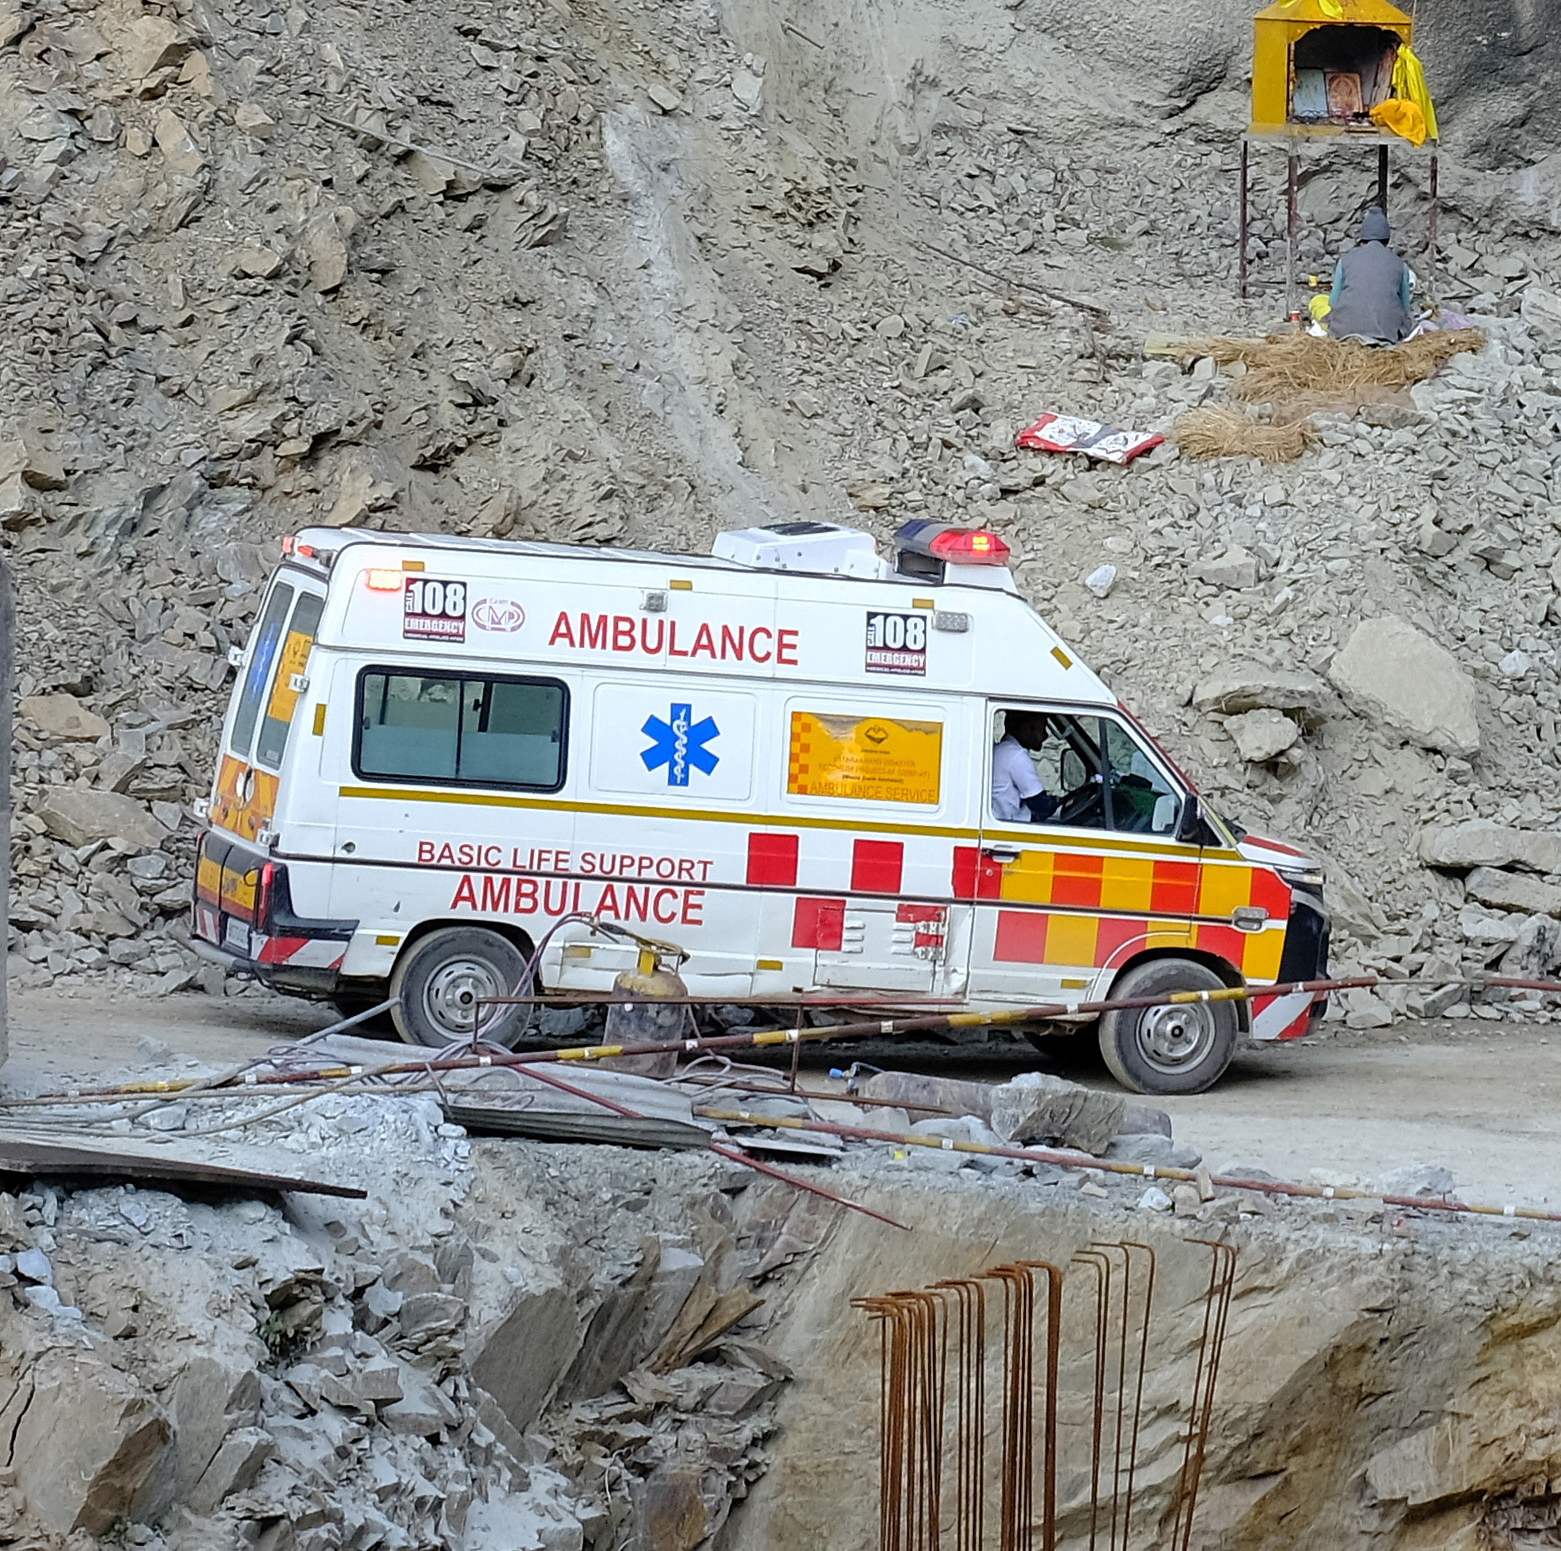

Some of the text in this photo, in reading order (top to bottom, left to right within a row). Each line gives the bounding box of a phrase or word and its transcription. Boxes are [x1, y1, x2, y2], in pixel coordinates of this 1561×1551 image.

[408, 580, 465, 618] 108
[404, 617, 465, 635] EMERGENCY
[548, 611, 799, 666] AMBULANCE
[869, 614, 925, 651] 108
[867, 651, 926, 668] EMERGENCY
[809, 780, 936, 802] AMBULANCE SERVICE
[417, 840, 714, 882] BASIC LIFE SUPPORT
[450, 874, 706, 927] AMBULANCE
